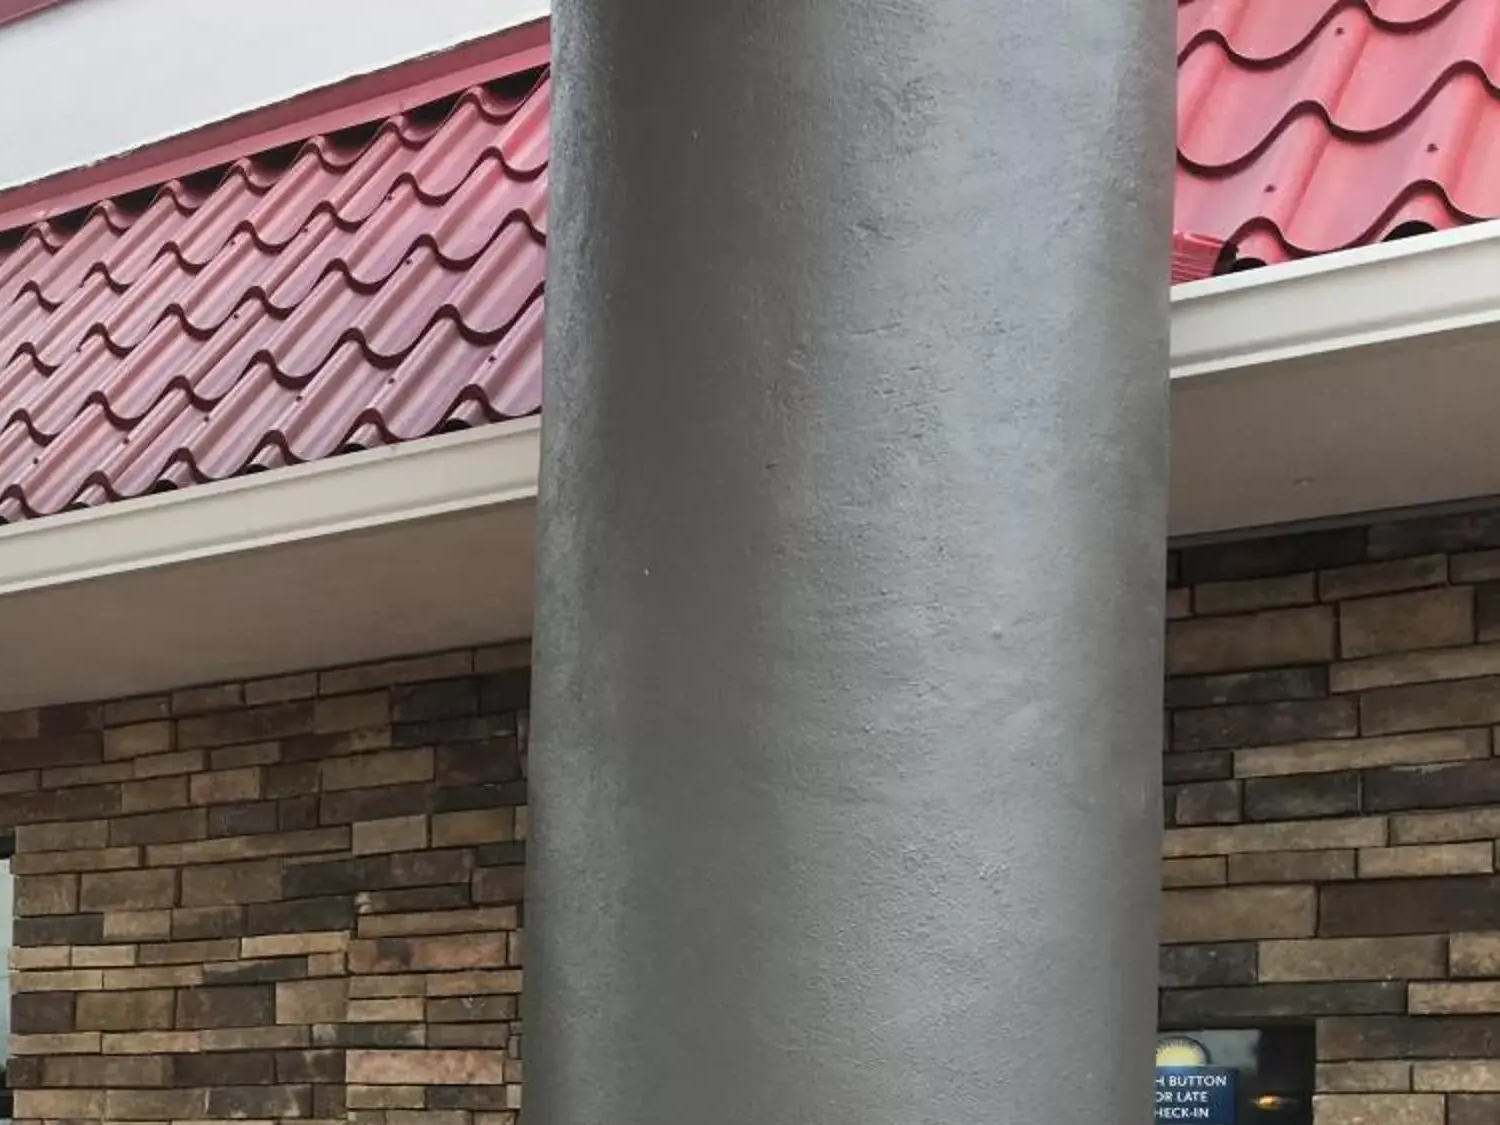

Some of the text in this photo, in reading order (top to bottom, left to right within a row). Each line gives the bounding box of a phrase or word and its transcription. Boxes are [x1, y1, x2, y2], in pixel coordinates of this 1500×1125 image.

[1169, 1075, 1227, 1087] BUTTON
[1155, 1091, 1209, 1103] OR LATE
[1154, 1107, 1210, 1119] HECK-IN
